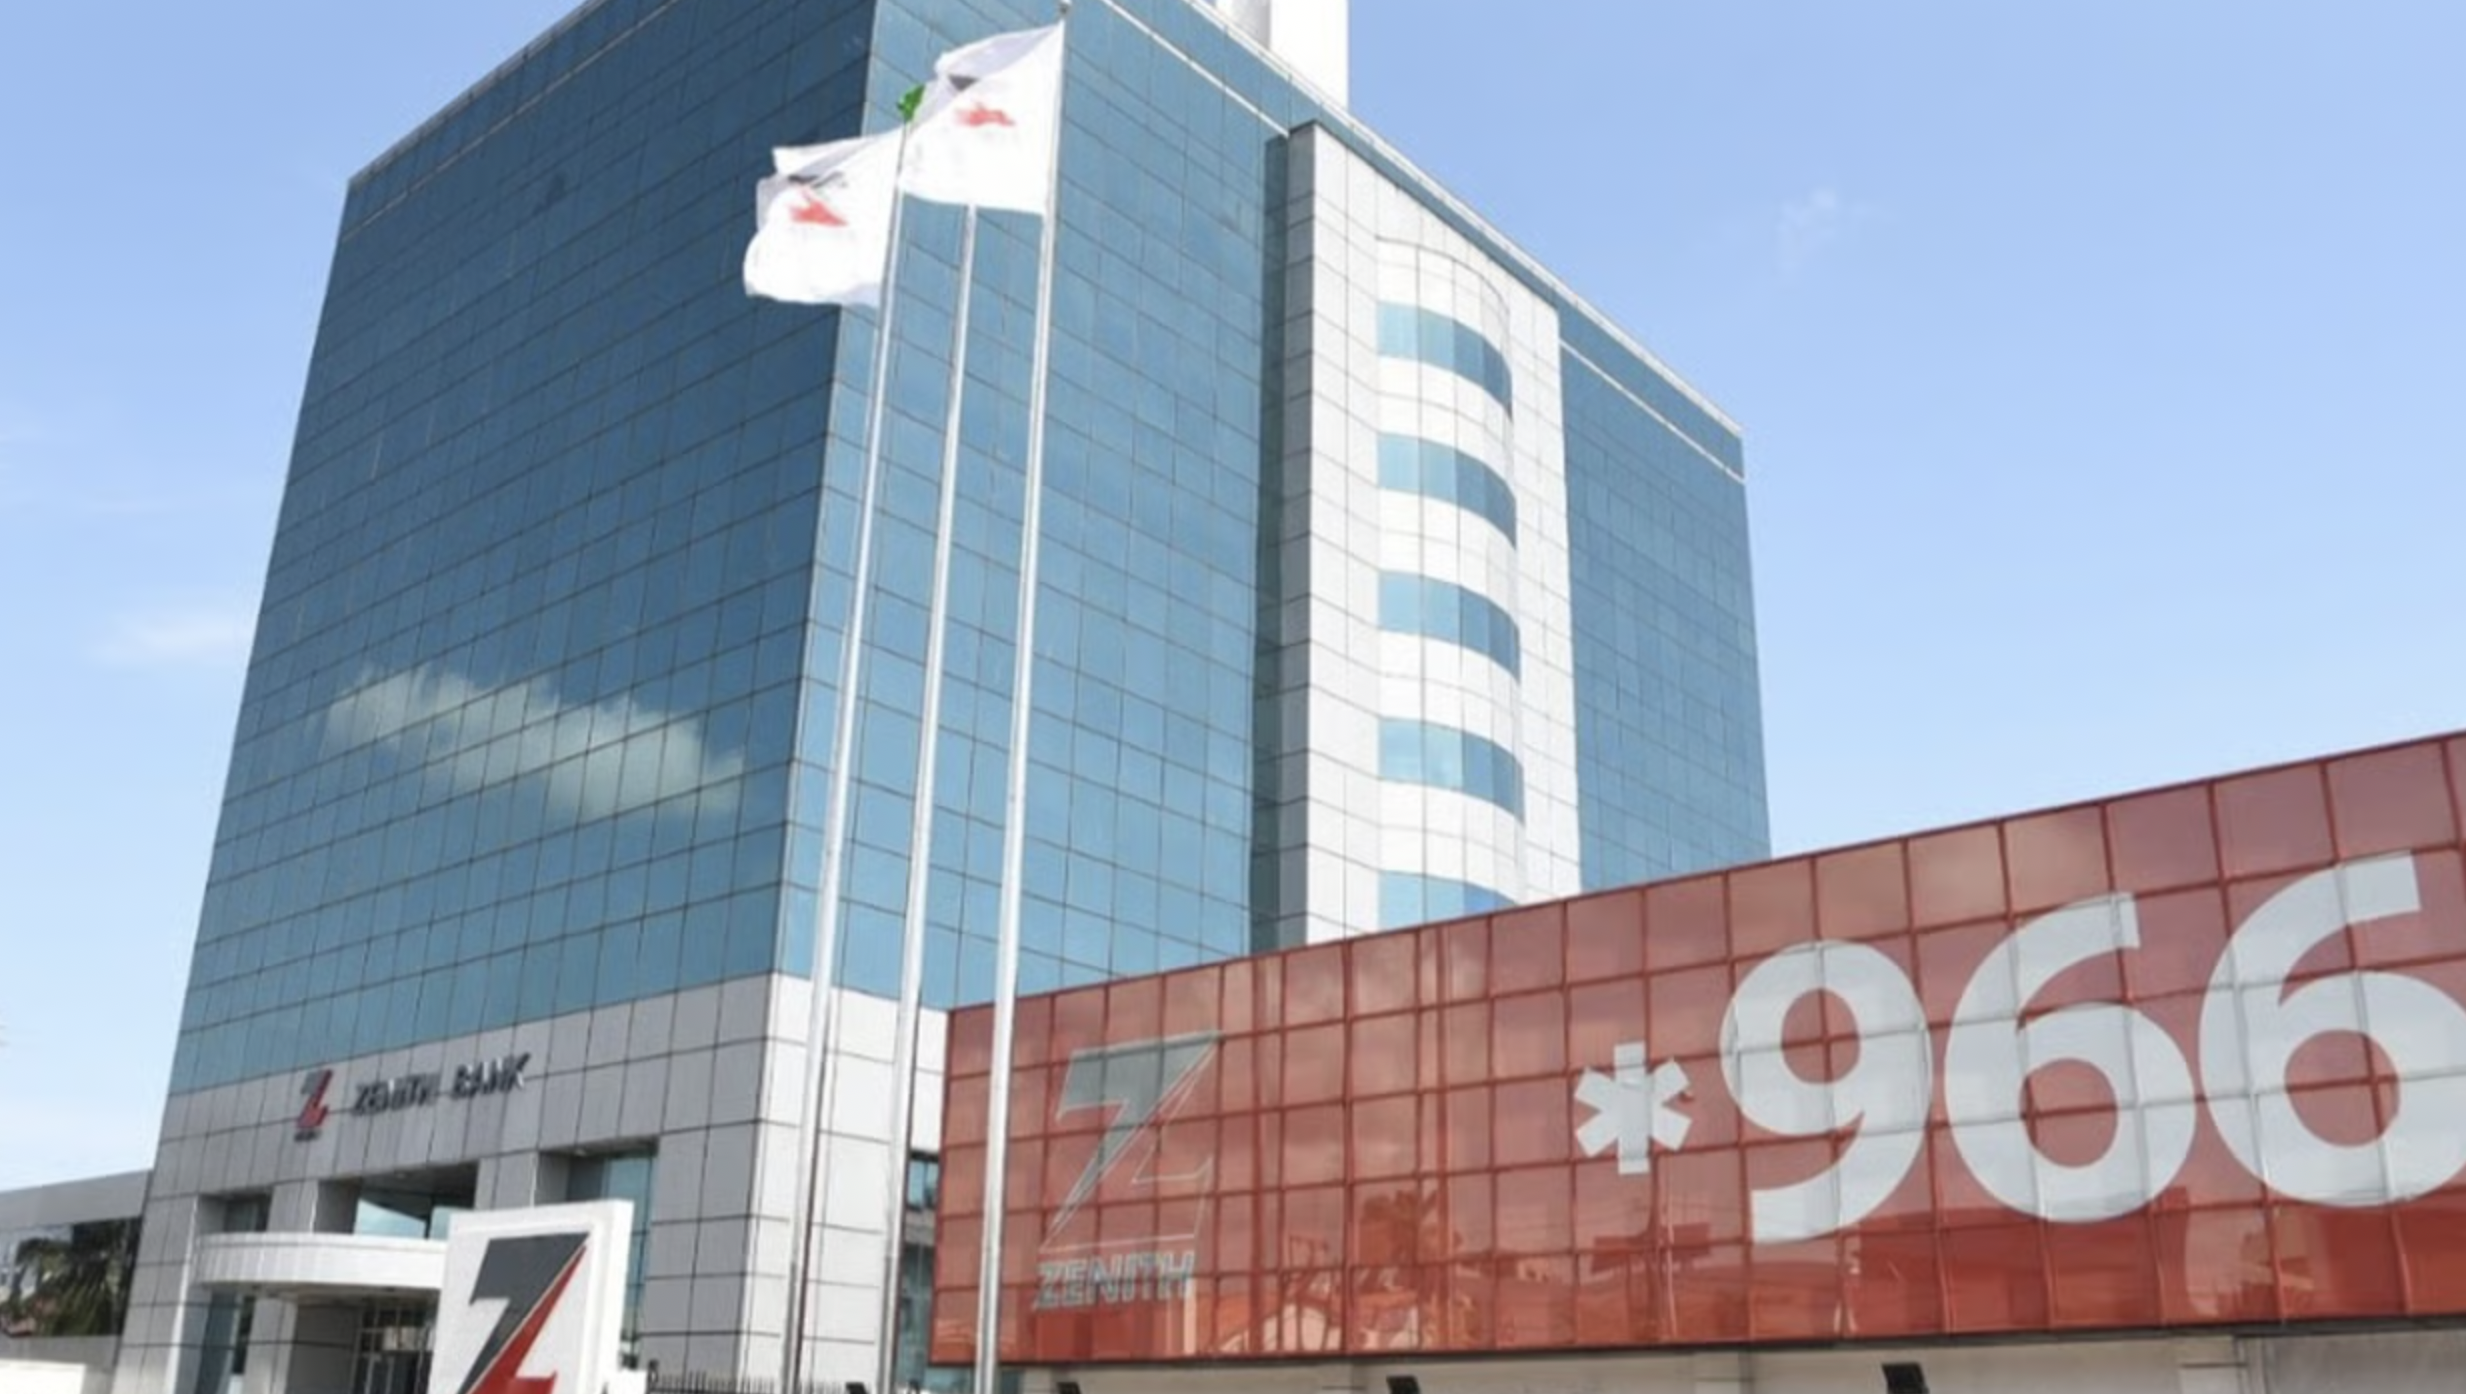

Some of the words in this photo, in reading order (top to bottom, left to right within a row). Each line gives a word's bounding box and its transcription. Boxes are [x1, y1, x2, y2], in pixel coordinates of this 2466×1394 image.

[350, 1072, 441, 1116] ZENITH
[449, 1052, 531, 1100] BANK
[1031, 1250, 1196, 1311] ZENITH
